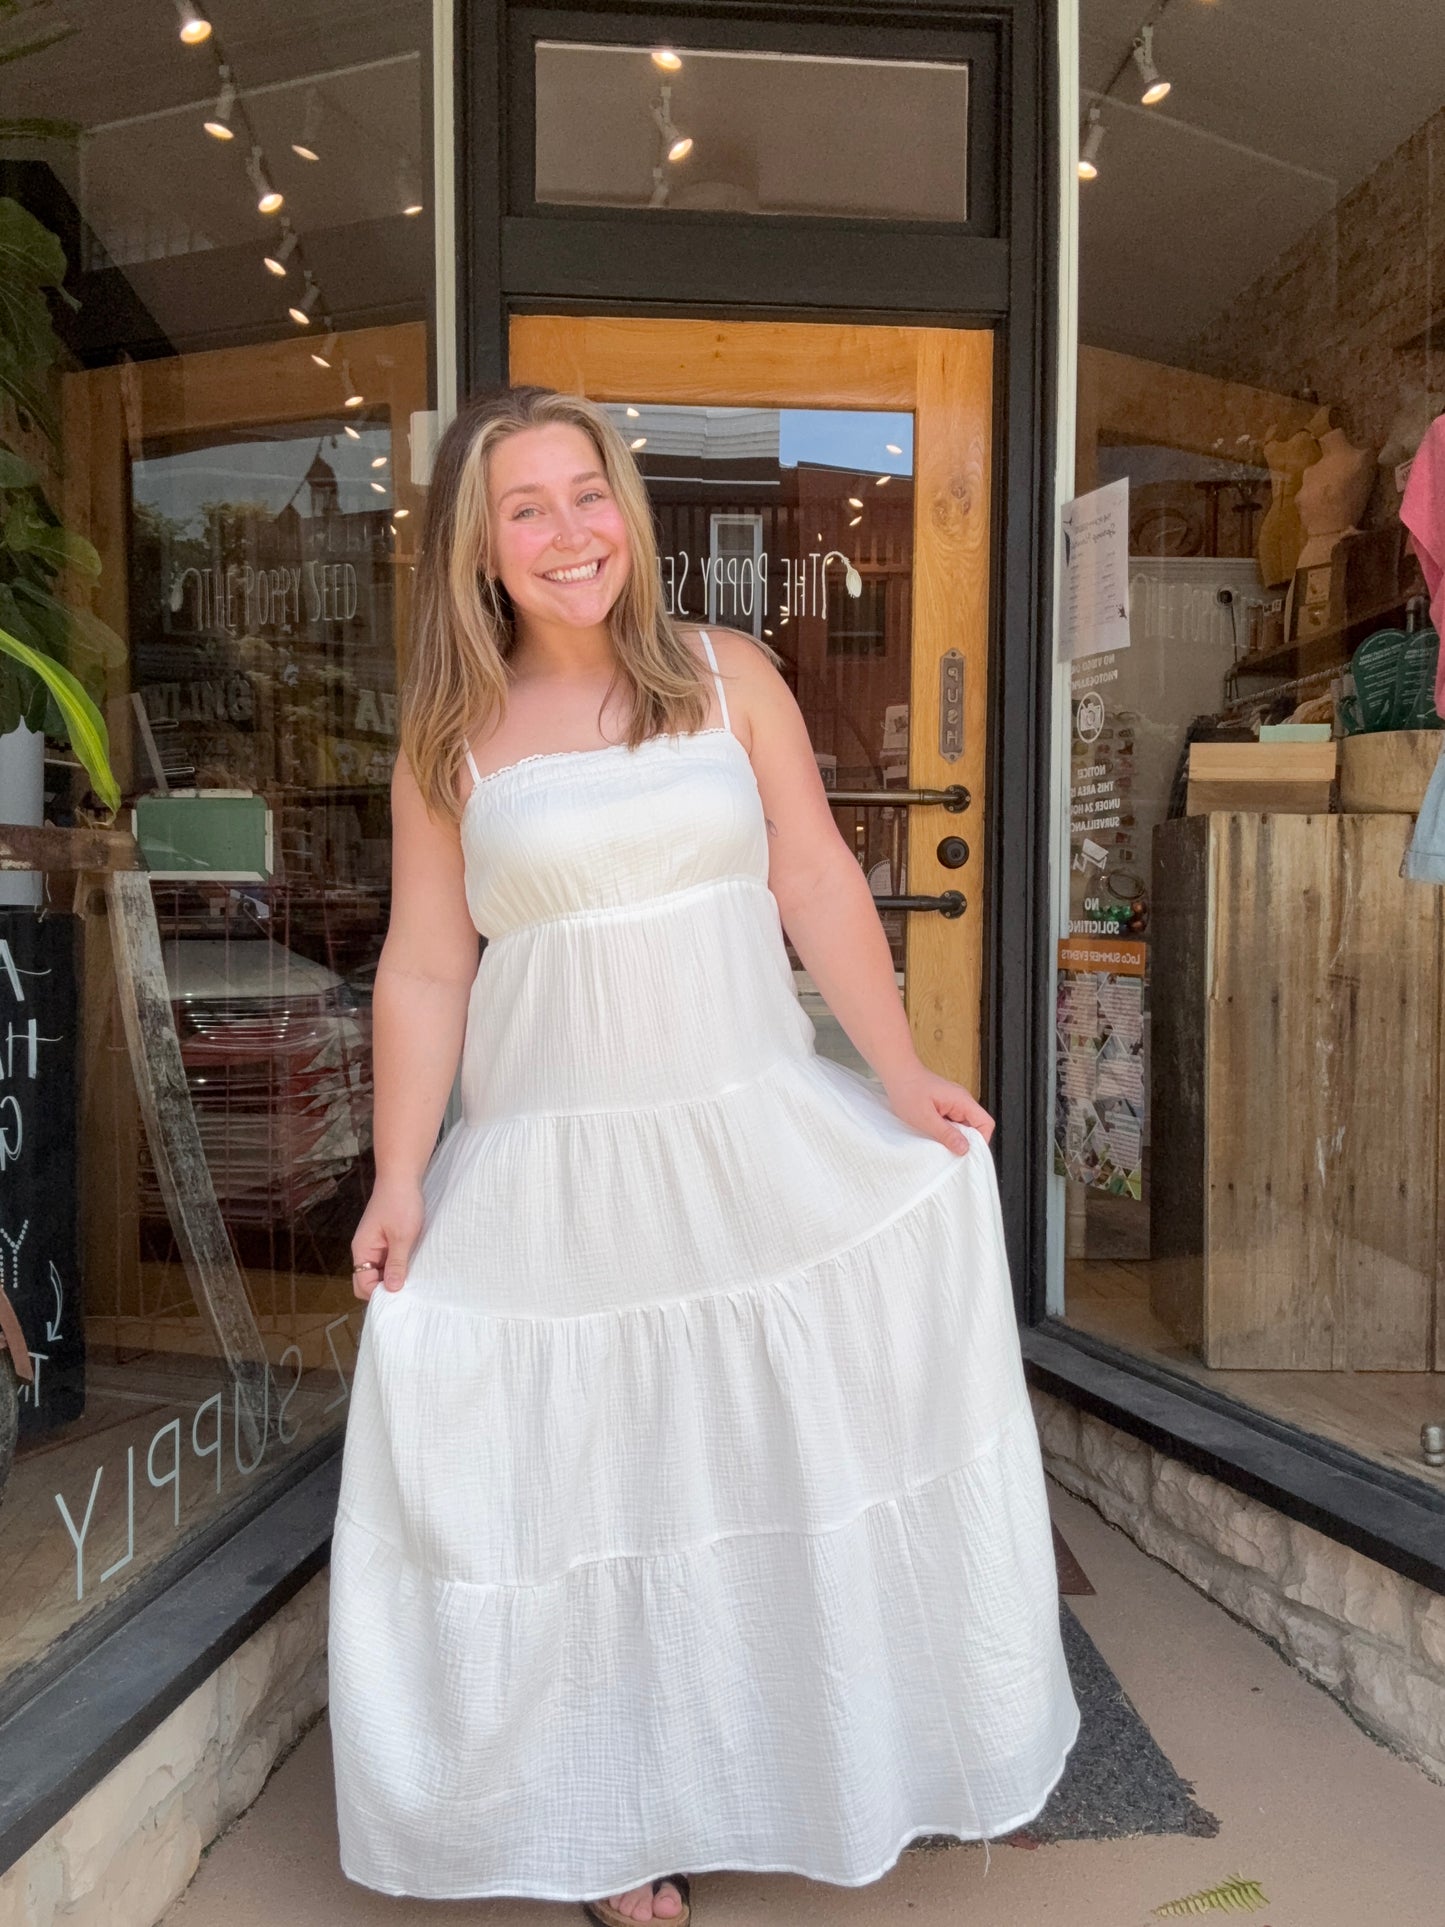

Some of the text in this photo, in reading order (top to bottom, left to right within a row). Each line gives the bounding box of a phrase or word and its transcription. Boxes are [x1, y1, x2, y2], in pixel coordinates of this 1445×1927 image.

[201, 560, 358, 629] THE POPPY SEED
